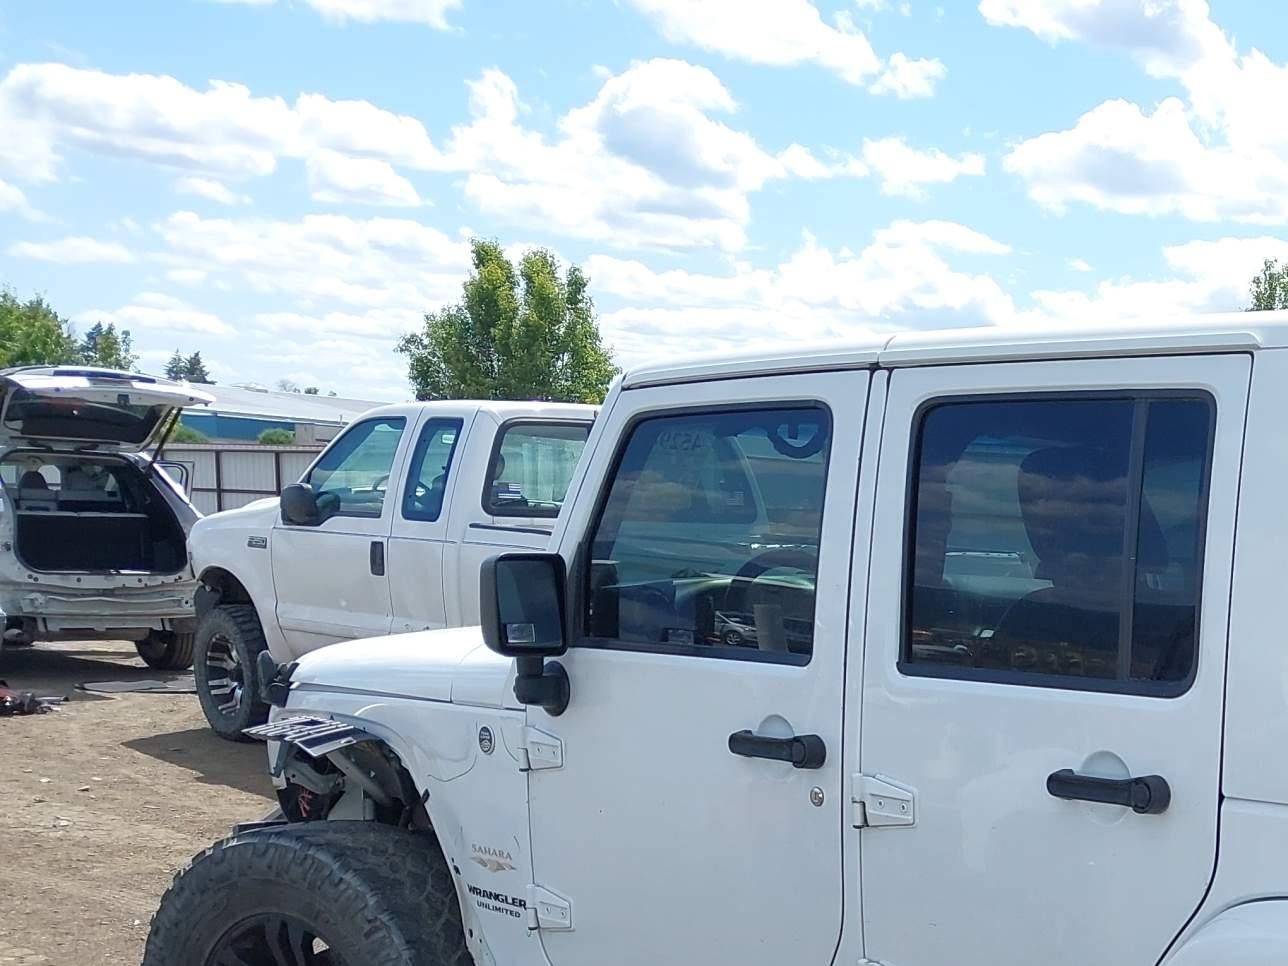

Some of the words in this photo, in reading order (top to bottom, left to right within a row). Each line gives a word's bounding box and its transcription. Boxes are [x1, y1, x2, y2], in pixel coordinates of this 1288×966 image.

[472, 843, 513, 861] SAHARA
[466, 884, 527, 910] WRANGLER
[476, 900, 521, 918] UNLIMITED
